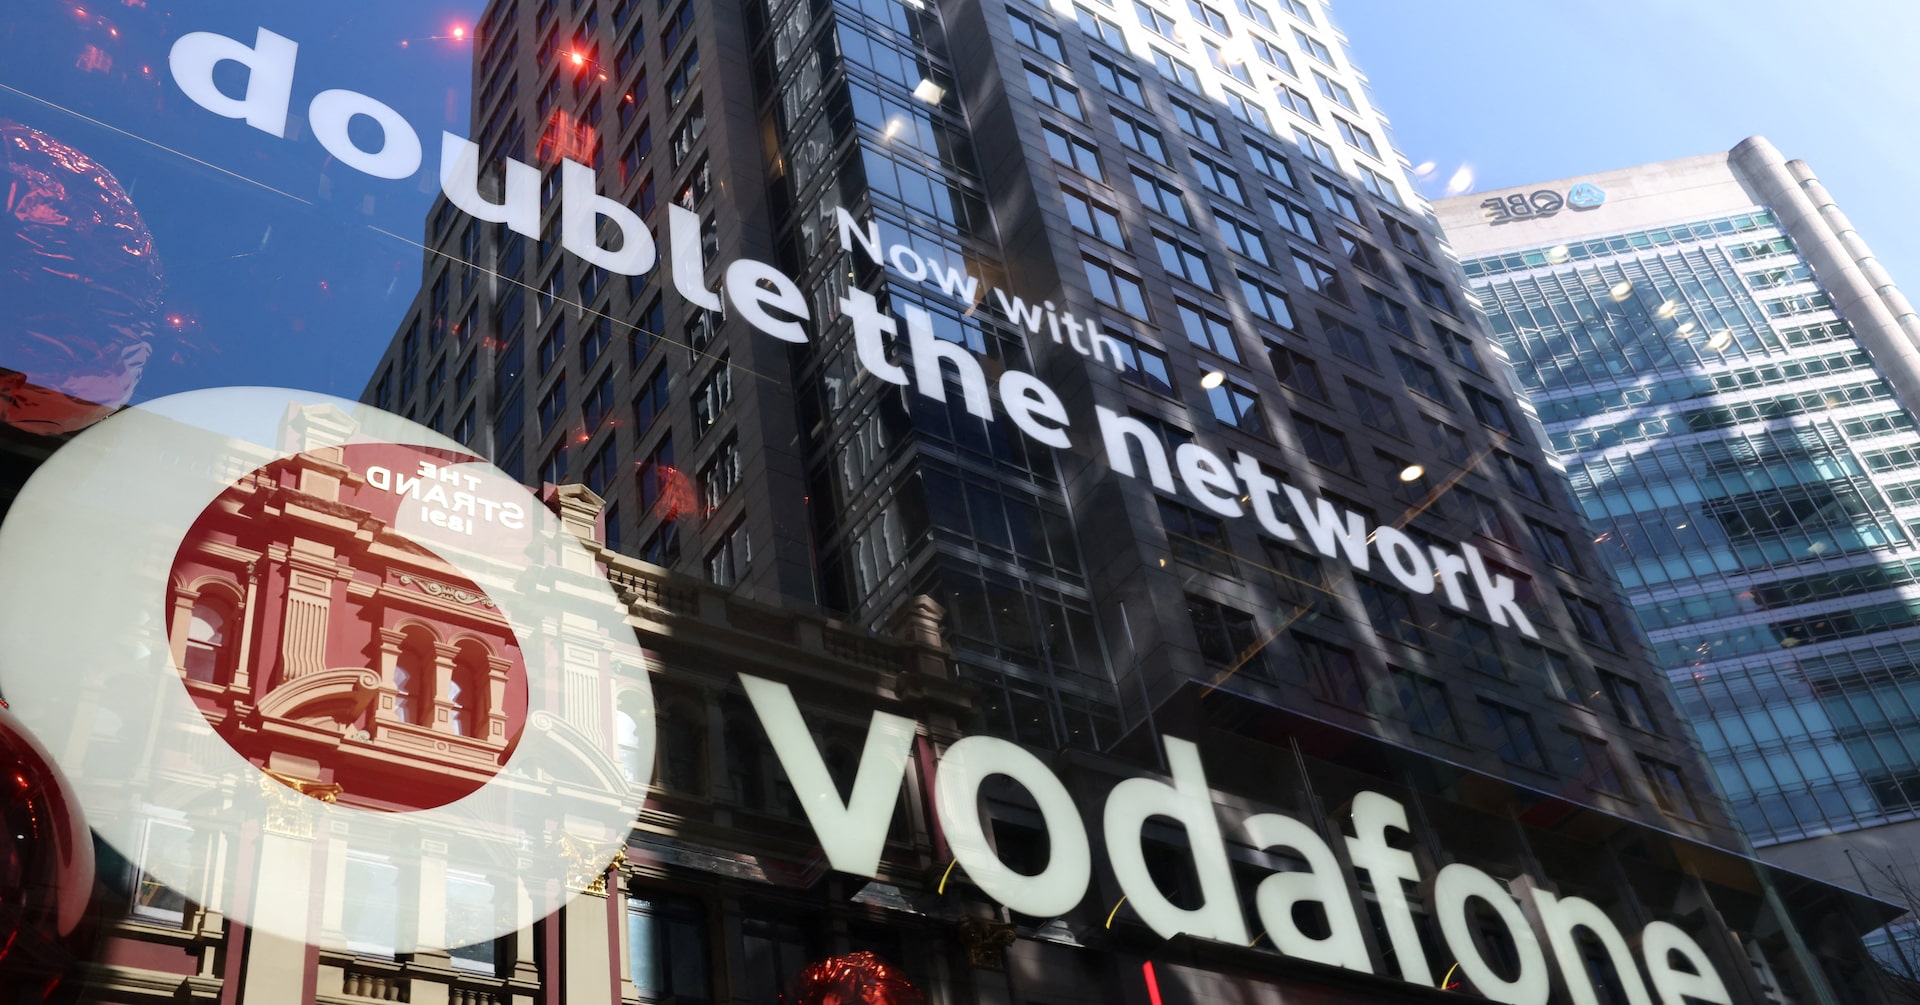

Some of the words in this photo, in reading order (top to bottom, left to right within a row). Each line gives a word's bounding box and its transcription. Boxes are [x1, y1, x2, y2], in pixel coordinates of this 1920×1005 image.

[168, 26, 809, 343] double
[840, 284, 1072, 449] the
[1095, 404, 1539, 640] network
[836, 205, 982, 307] Now
[993, 287, 1126, 373] with
[737, 672, 1733, 1005] vodafone
